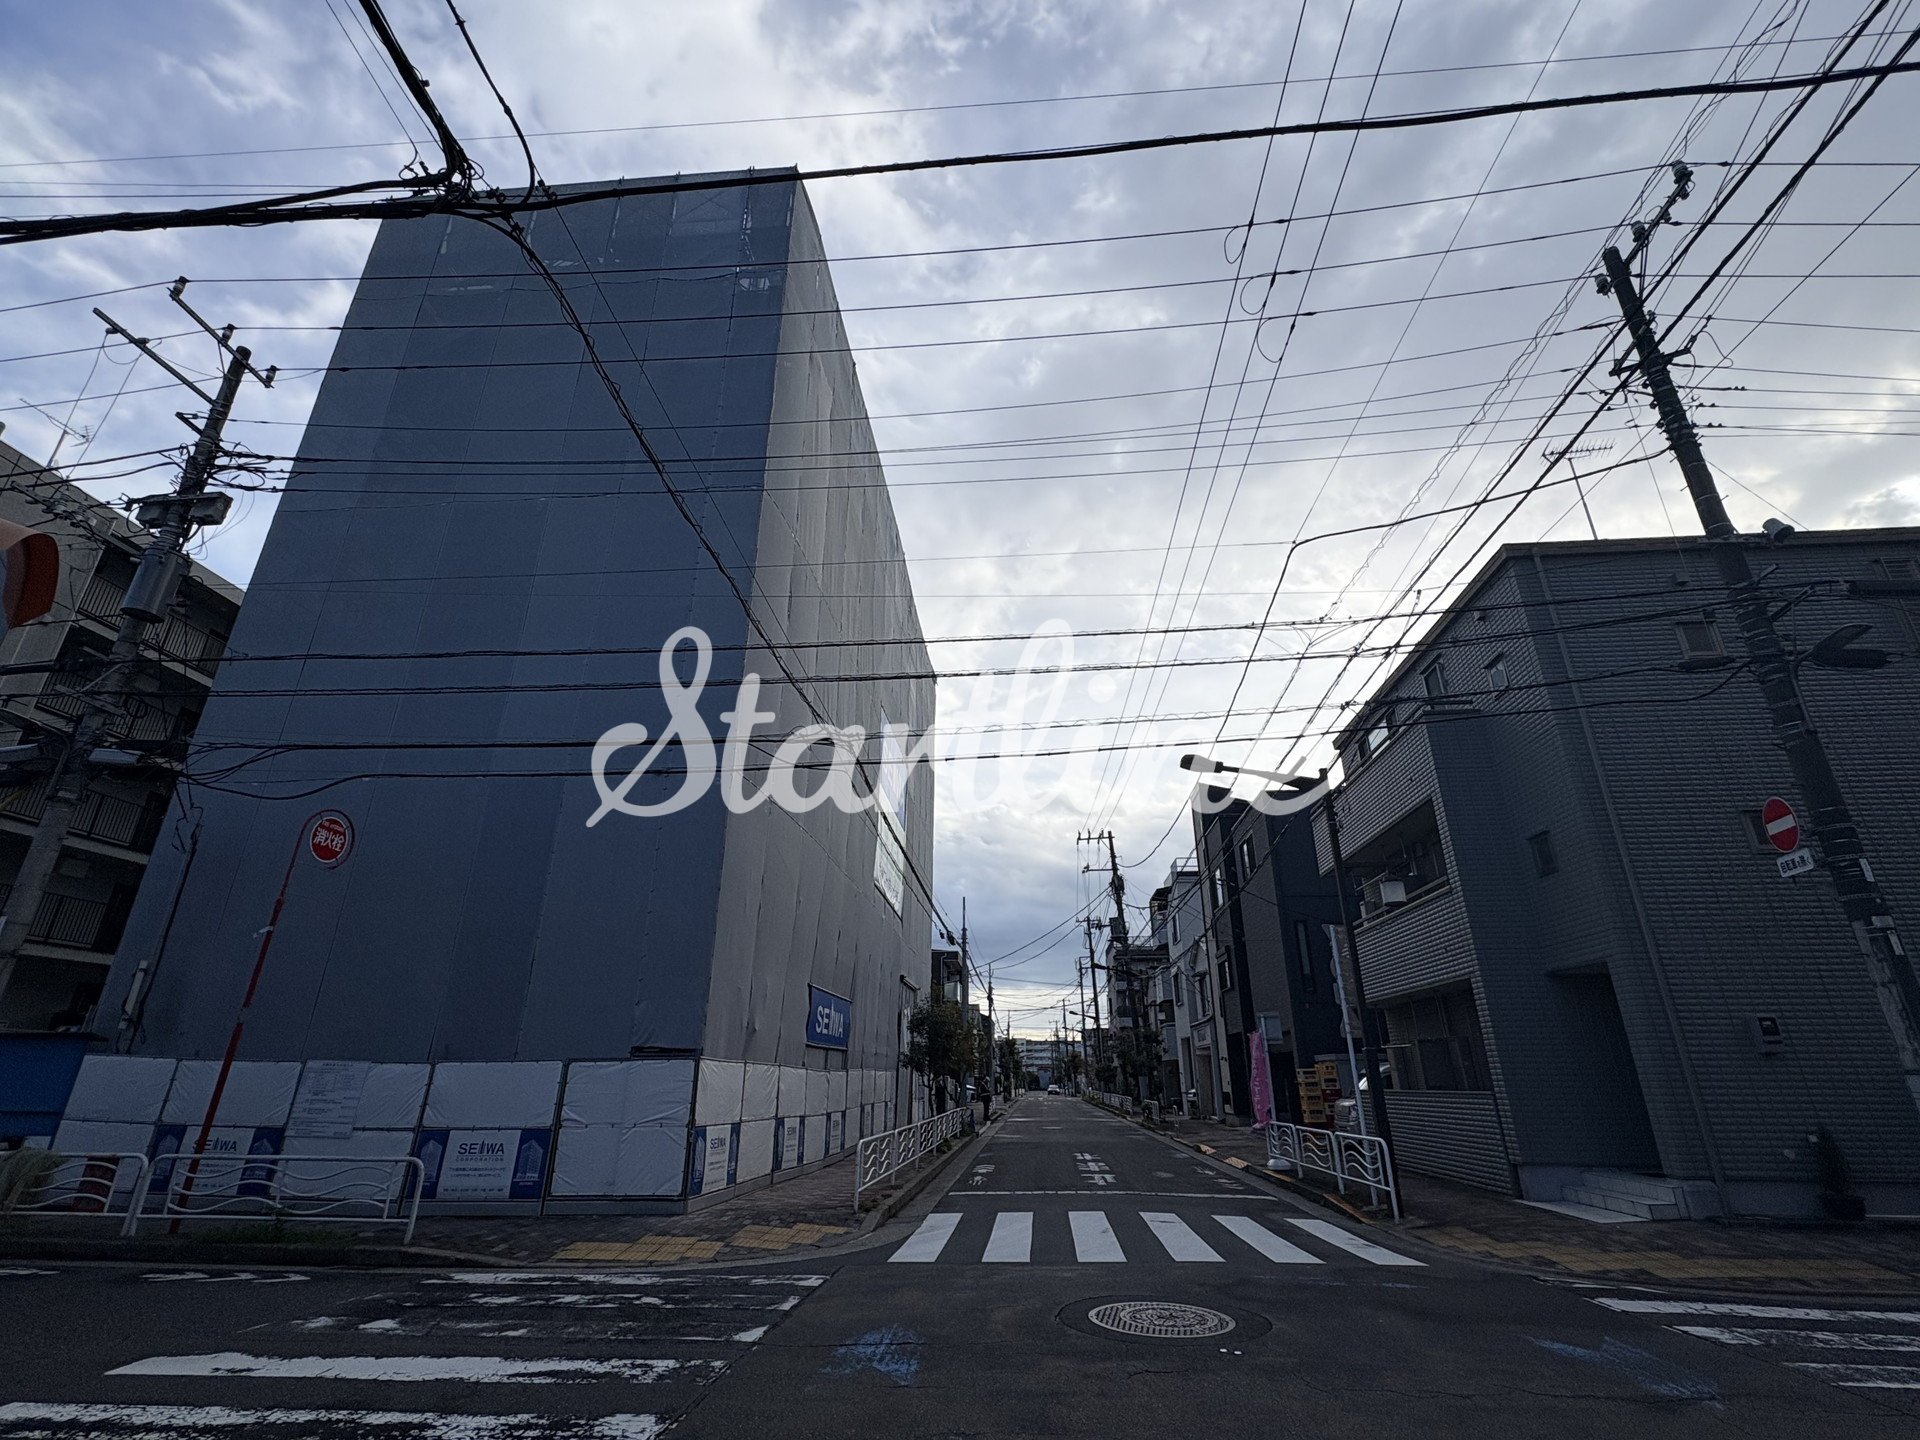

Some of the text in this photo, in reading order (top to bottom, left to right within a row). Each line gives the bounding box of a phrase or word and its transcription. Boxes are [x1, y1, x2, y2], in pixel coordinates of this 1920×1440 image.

[313, 826, 345, 852] 消火栓
[815, 998, 843, 1038] SEIWA
[458, 1140, 504, 1155] SEIWA
